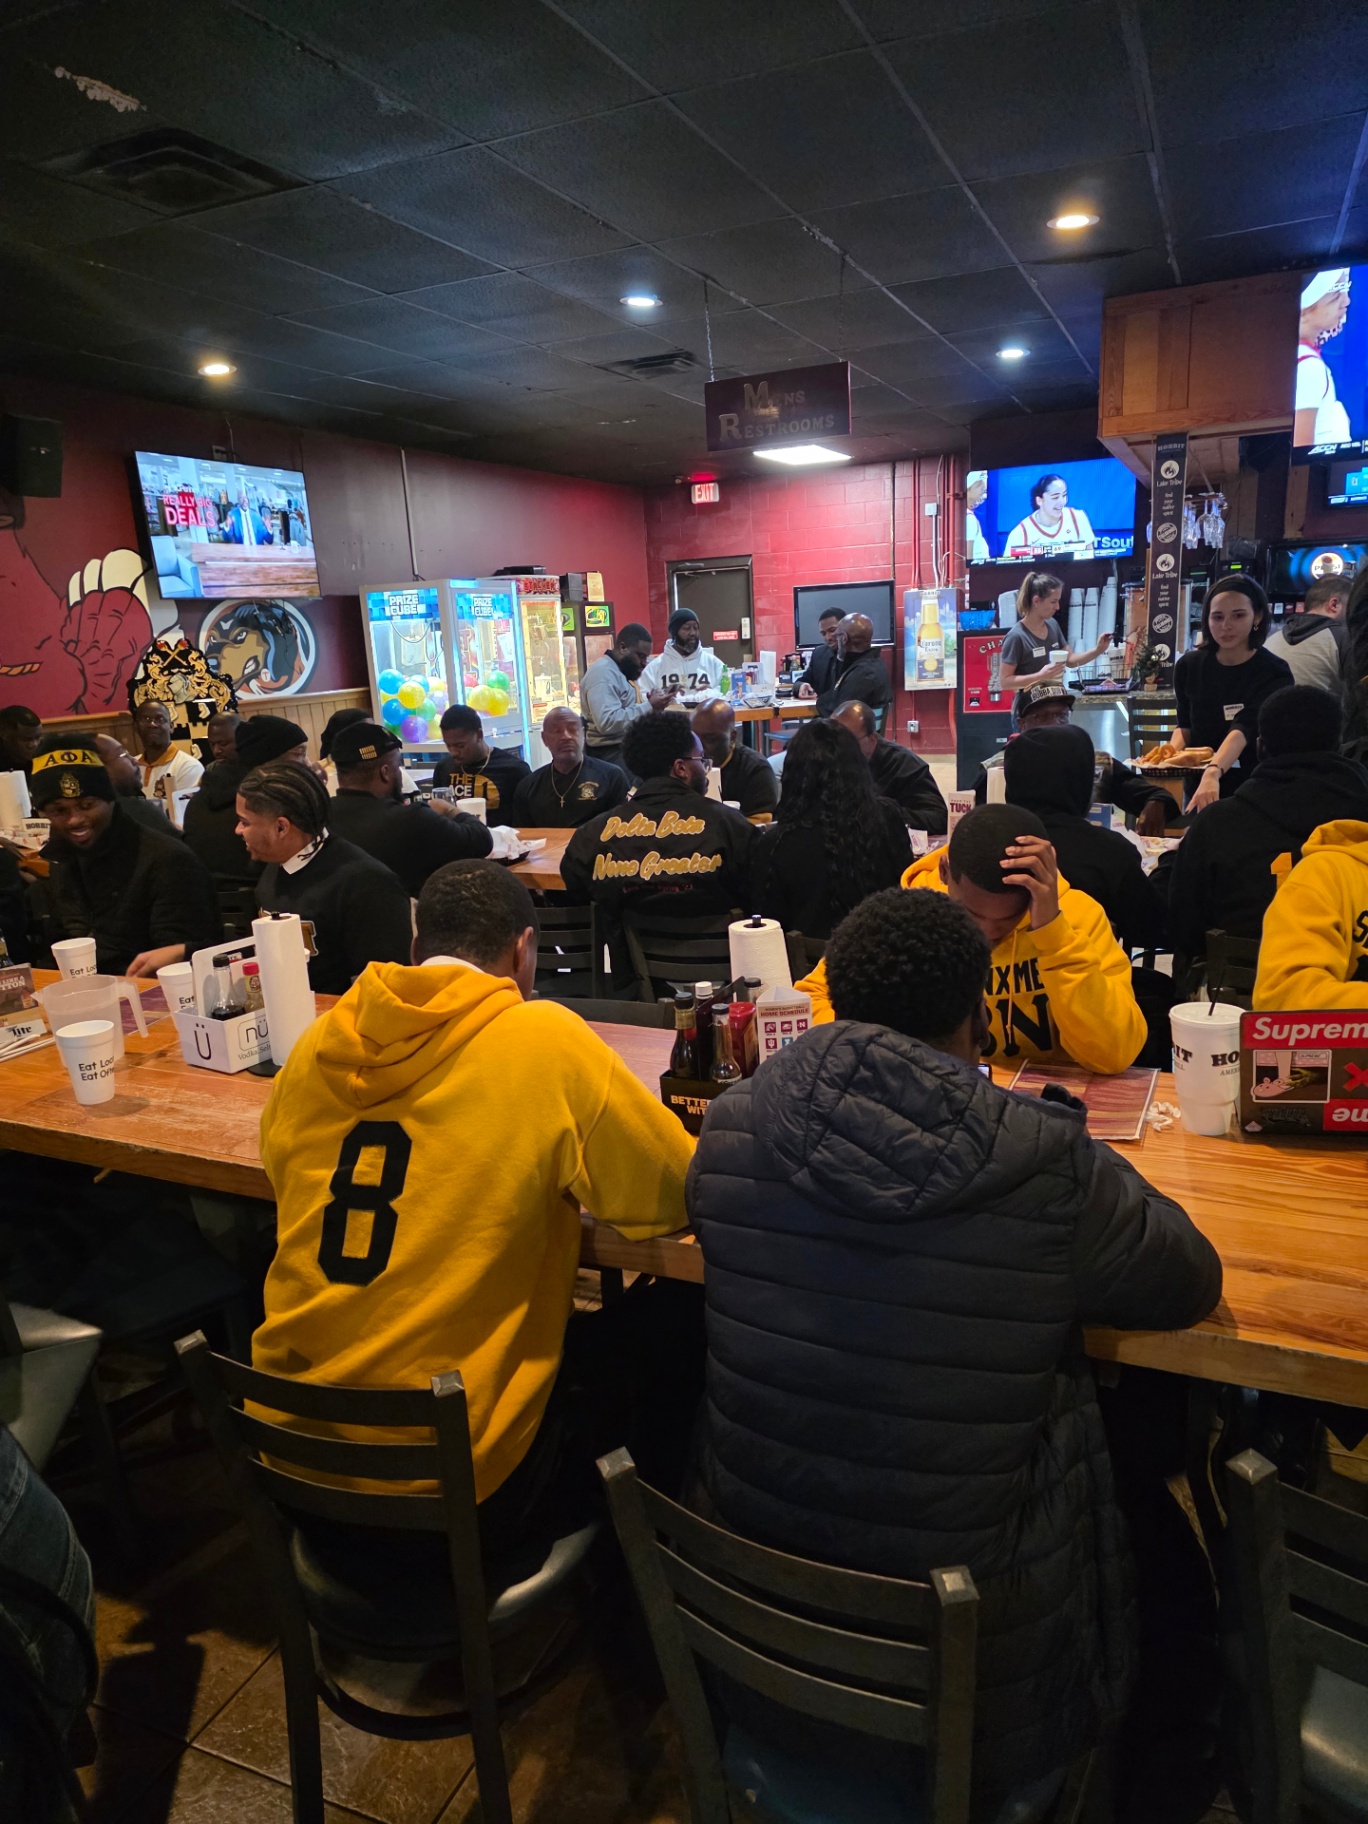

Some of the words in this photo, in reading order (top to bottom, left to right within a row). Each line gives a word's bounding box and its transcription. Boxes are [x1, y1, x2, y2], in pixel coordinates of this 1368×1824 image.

[719, 413, 835, 441] RESTROOMS
[1170, 478, 1183, 486] Tribe
[695, 483, 715, 500] EXIT
[163, 495, 196, 507] REALLY
[165, 507, 217, 527] DEALS
[389, 594, 419, 605] PRIZE
[473, 596, 493, 607] PRIZE
[390, 605, 418, 616] CUBE
[474, 606, 493, 617] CUBE
[450, 774, 472, 784] THE
[950, 803, 971, 813] TUCK
[655, 811, 705, 838] Beta
[593, 853, 639, 880] None
[640, 851, 722, 880] Greater
[70, 967, 84, 976] Eat
[179, 996, 195, 1005] Eat
[780, 1008, 809, 1016] SCHEDULE
[78, 1062, 97, 1071] Eat
[81, 1072, 98, 1081] Eat
[317, 1120, 413, 1287] 8
